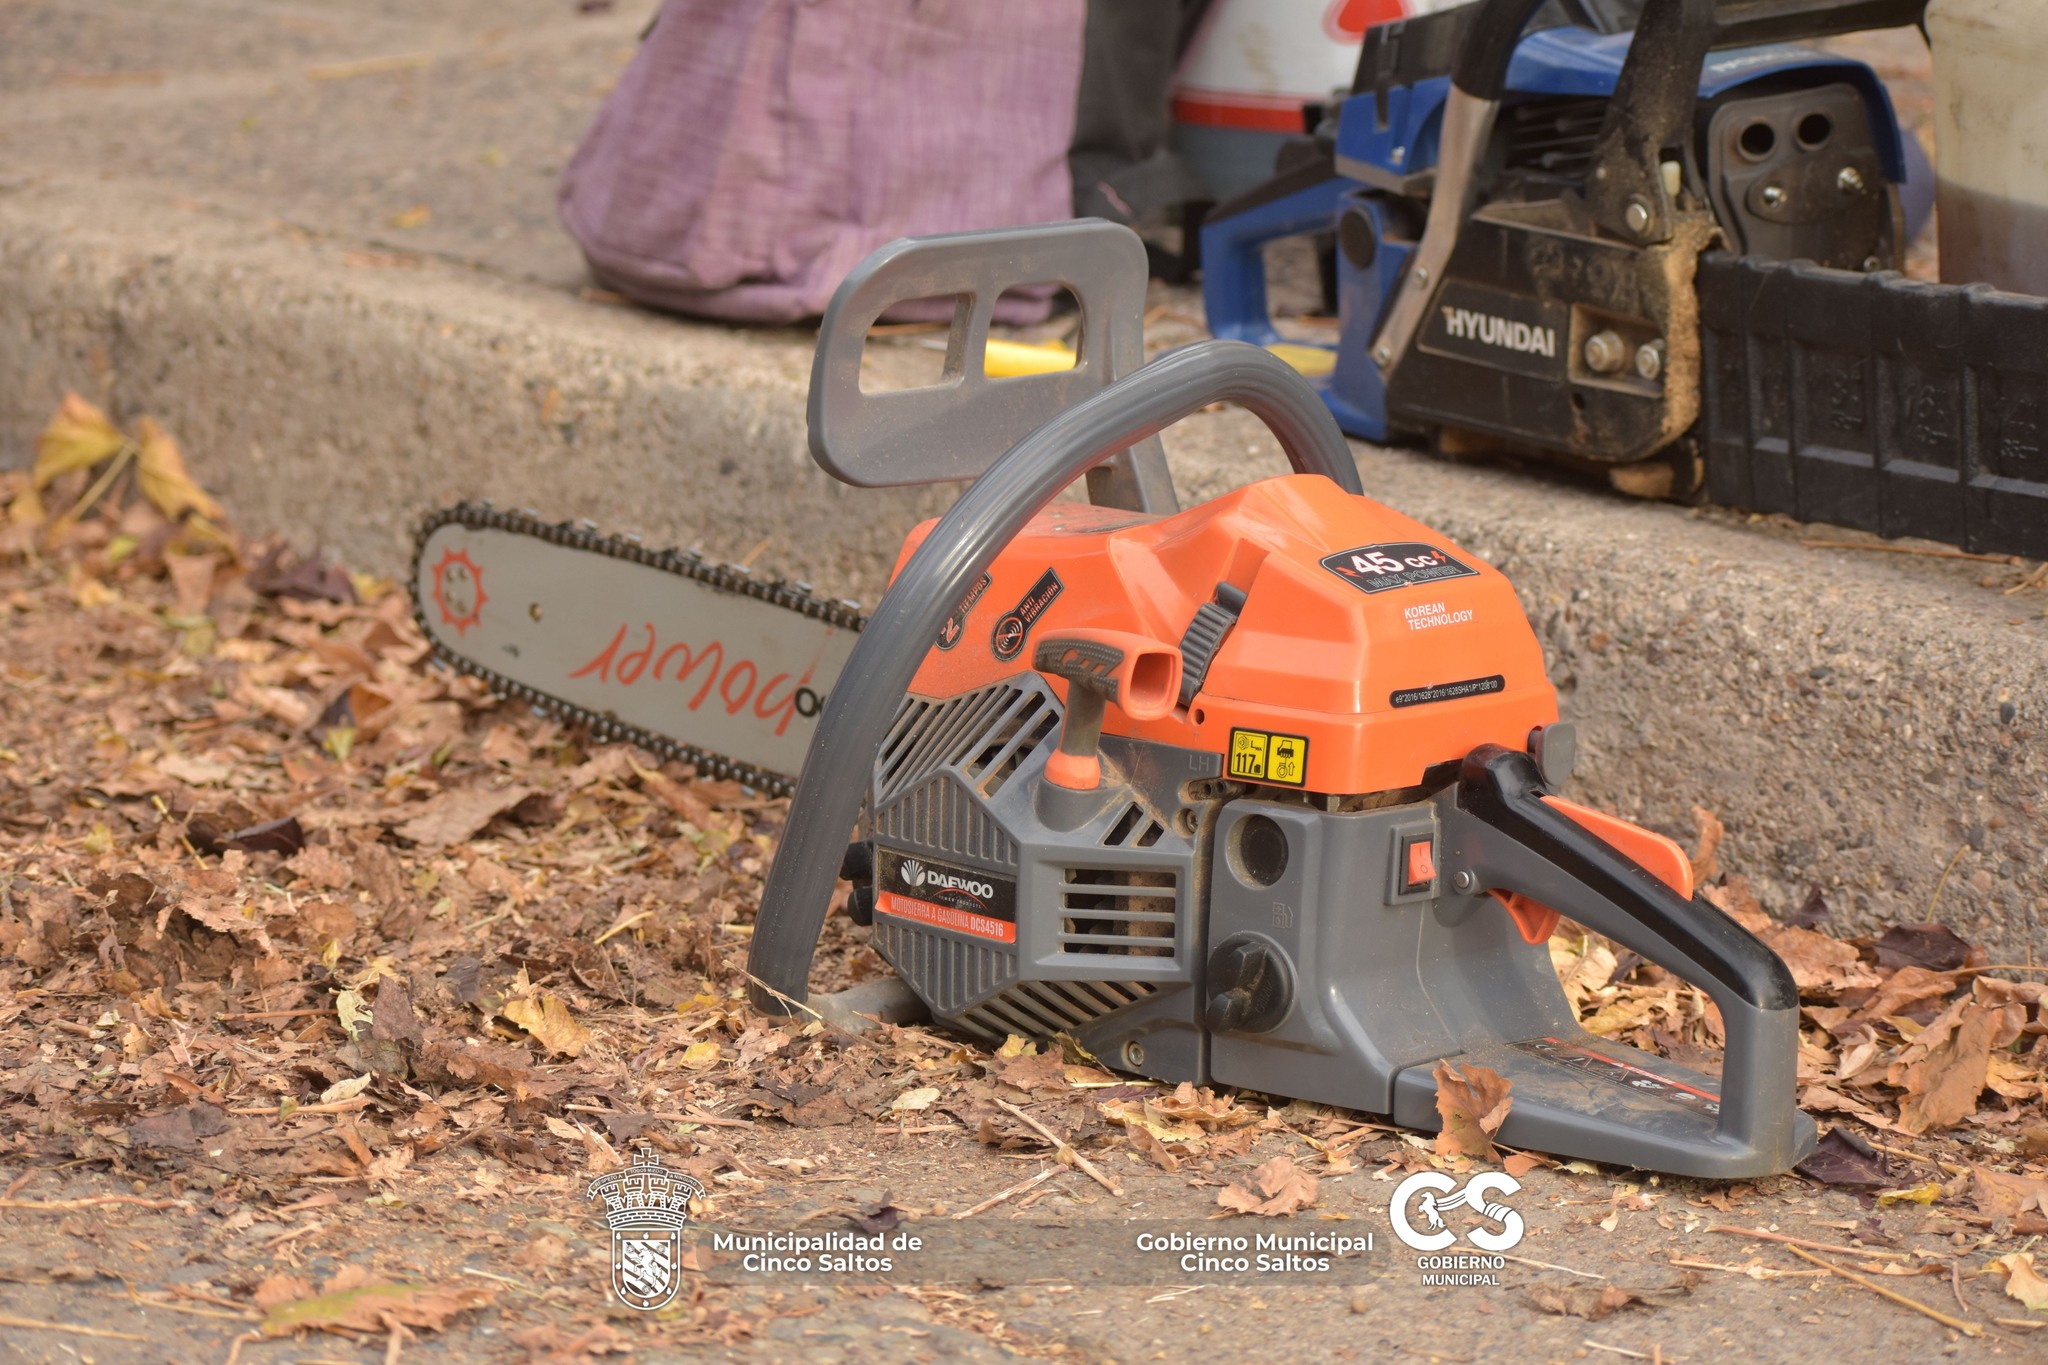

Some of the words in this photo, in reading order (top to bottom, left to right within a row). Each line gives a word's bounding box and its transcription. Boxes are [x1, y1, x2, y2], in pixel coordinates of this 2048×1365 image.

[1441, 305, 1555, 357] HYUNDAI
[1350, 551, 1405, 575] 45
[1367, 574, 1403, 588] MAX
[1404, 565, 1463, 581] POWER
[1019, 595, 1036, 617] ANTI
[1024, 582, 1060, 623] VIBRACIÓN
[1404, 602, 1446, 620] KOREAN
[1408, 609, 1474, 632] TECHNOLOGY
[1236, 752, 1257, 774] 117
[927, 870, 994, 899] DAEWOO
[890, 896, 931, 919] MOTOSIERRA
[931, 910, 937, 920] A
[937, 907, 970, 929] GASOLINA
[970, 916, 1004, 937] DCS4516
